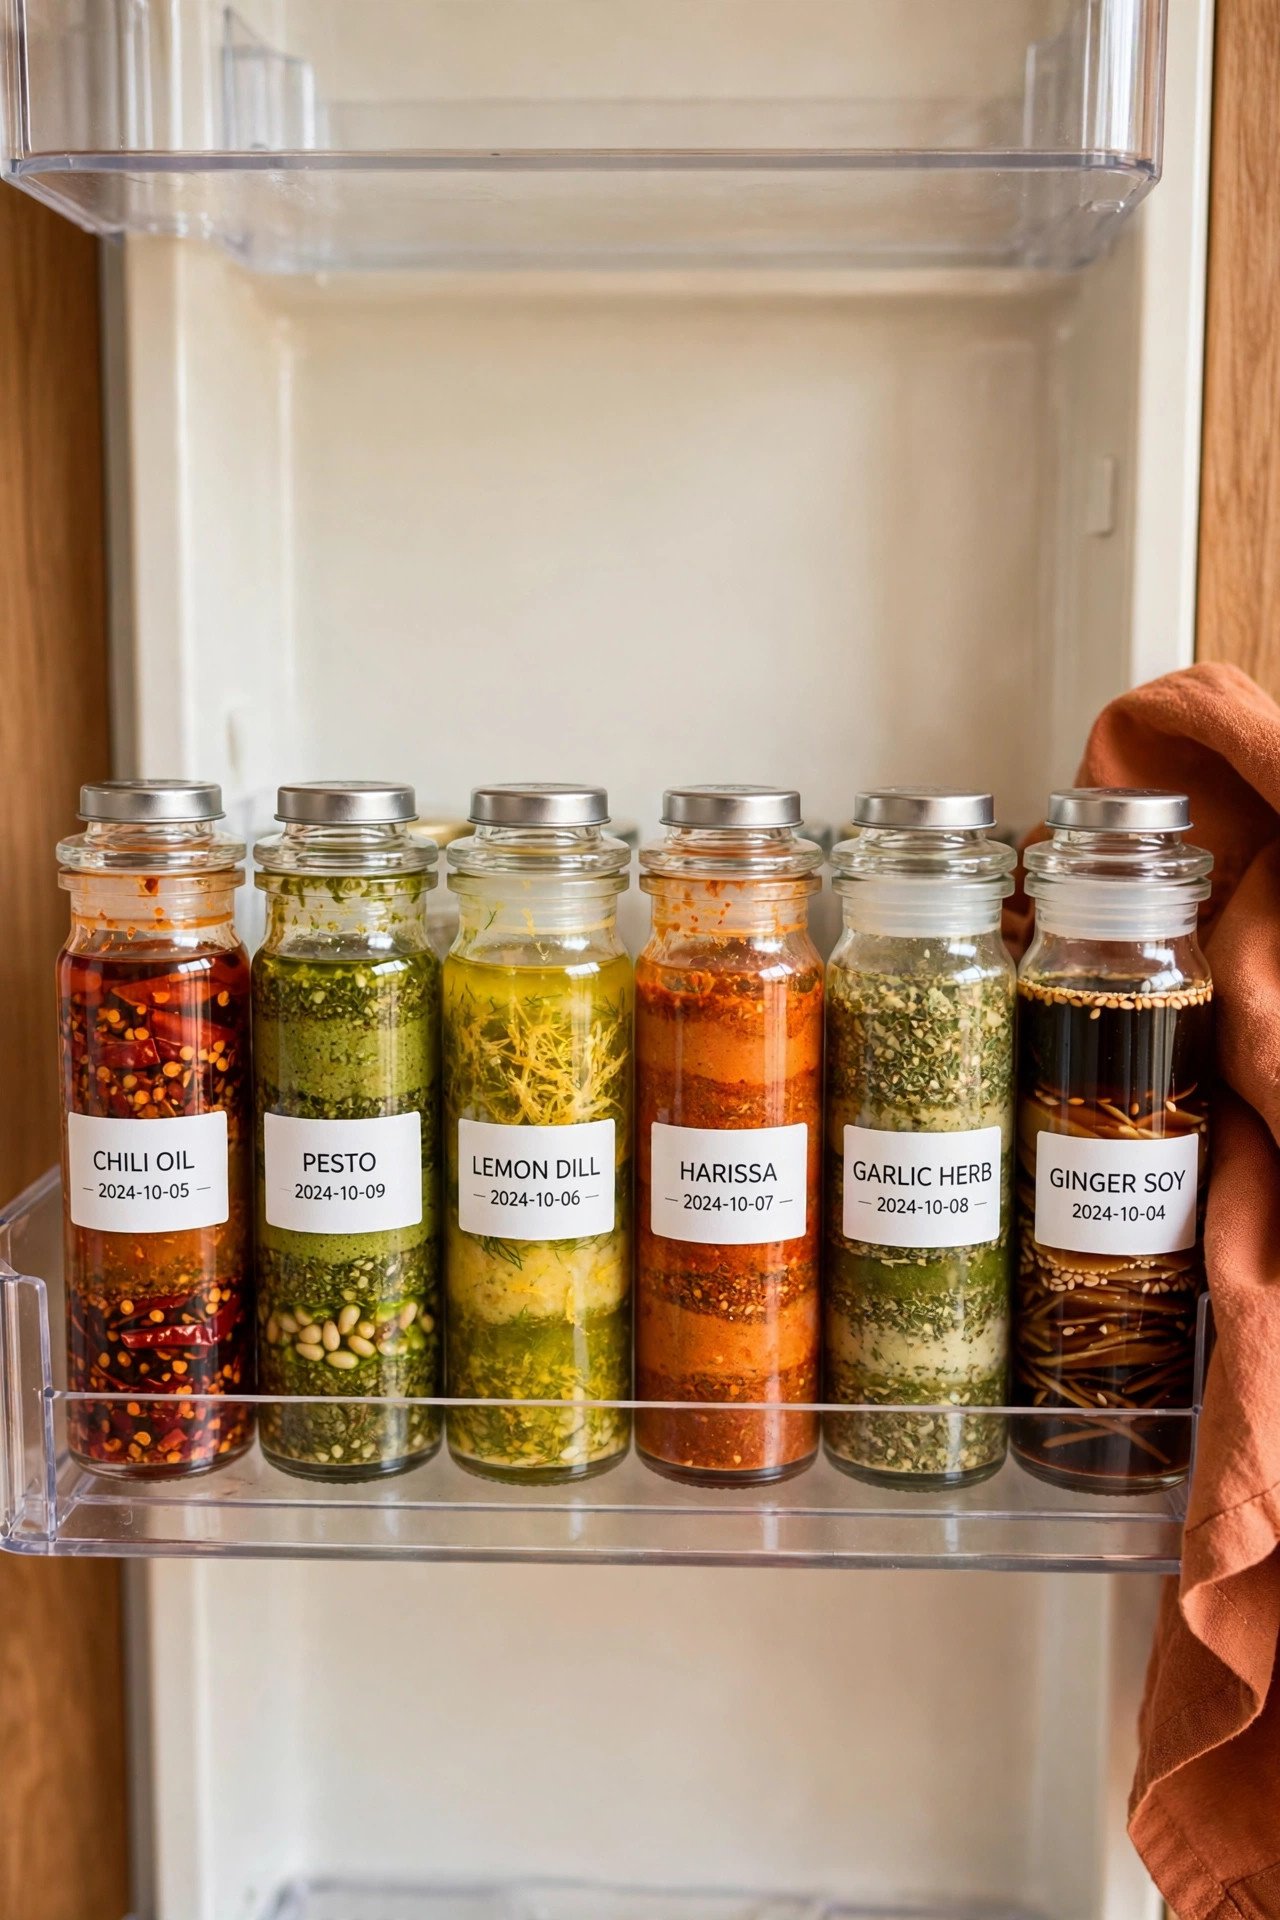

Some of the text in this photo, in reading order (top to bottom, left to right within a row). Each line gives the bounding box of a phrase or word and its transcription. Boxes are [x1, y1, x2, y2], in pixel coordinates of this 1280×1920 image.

[93, 1150, 195, 1172] CHILI OIL
[303, 1152, 377, 1174] PESTO
[472, 1155, 601, 1180] LEMON DILL
[680, 1160, 778, 1184] HARISSA
[852, 1160, 992, 1187] GARLIC HERB
[1049, 1167, 1186, 1194] GINGER SOY
[98, 1182, 190, 1200] 2024-10-05
[294, 1183, 386, 1201] 2024-10-09
[490, 1189, 581, 1208] 2024-10-06
[683, 1193, 774, 1212] 2024-10-07
[877, 1196, 969, 1215] 2024-10-08
[1072, 1202, 1166, 1222] 2024-10-04
